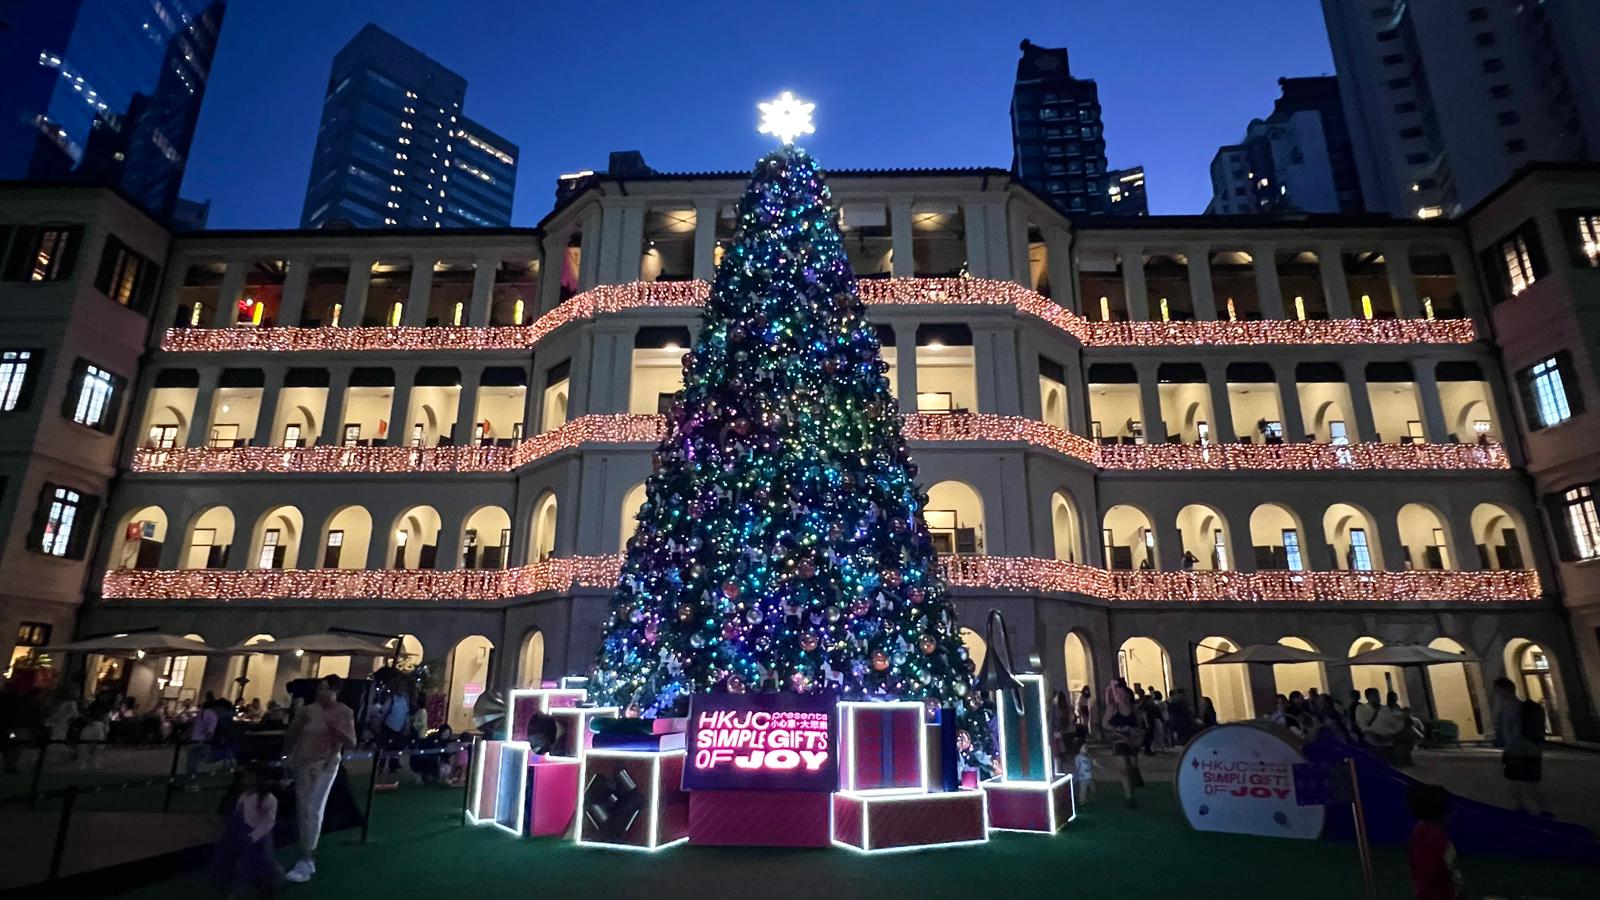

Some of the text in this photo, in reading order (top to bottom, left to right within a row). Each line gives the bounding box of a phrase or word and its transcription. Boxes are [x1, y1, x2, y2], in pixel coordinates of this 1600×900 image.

[699, 711, 828, 730] HKJC presents
[697, 730, 828, 749] SIMPLE GIFTS
[695, 750, 828, 769] OF JOY
[1202, 760, 1248, 772] HKJC
[1204, 784, 1291, 799] OF JOY
